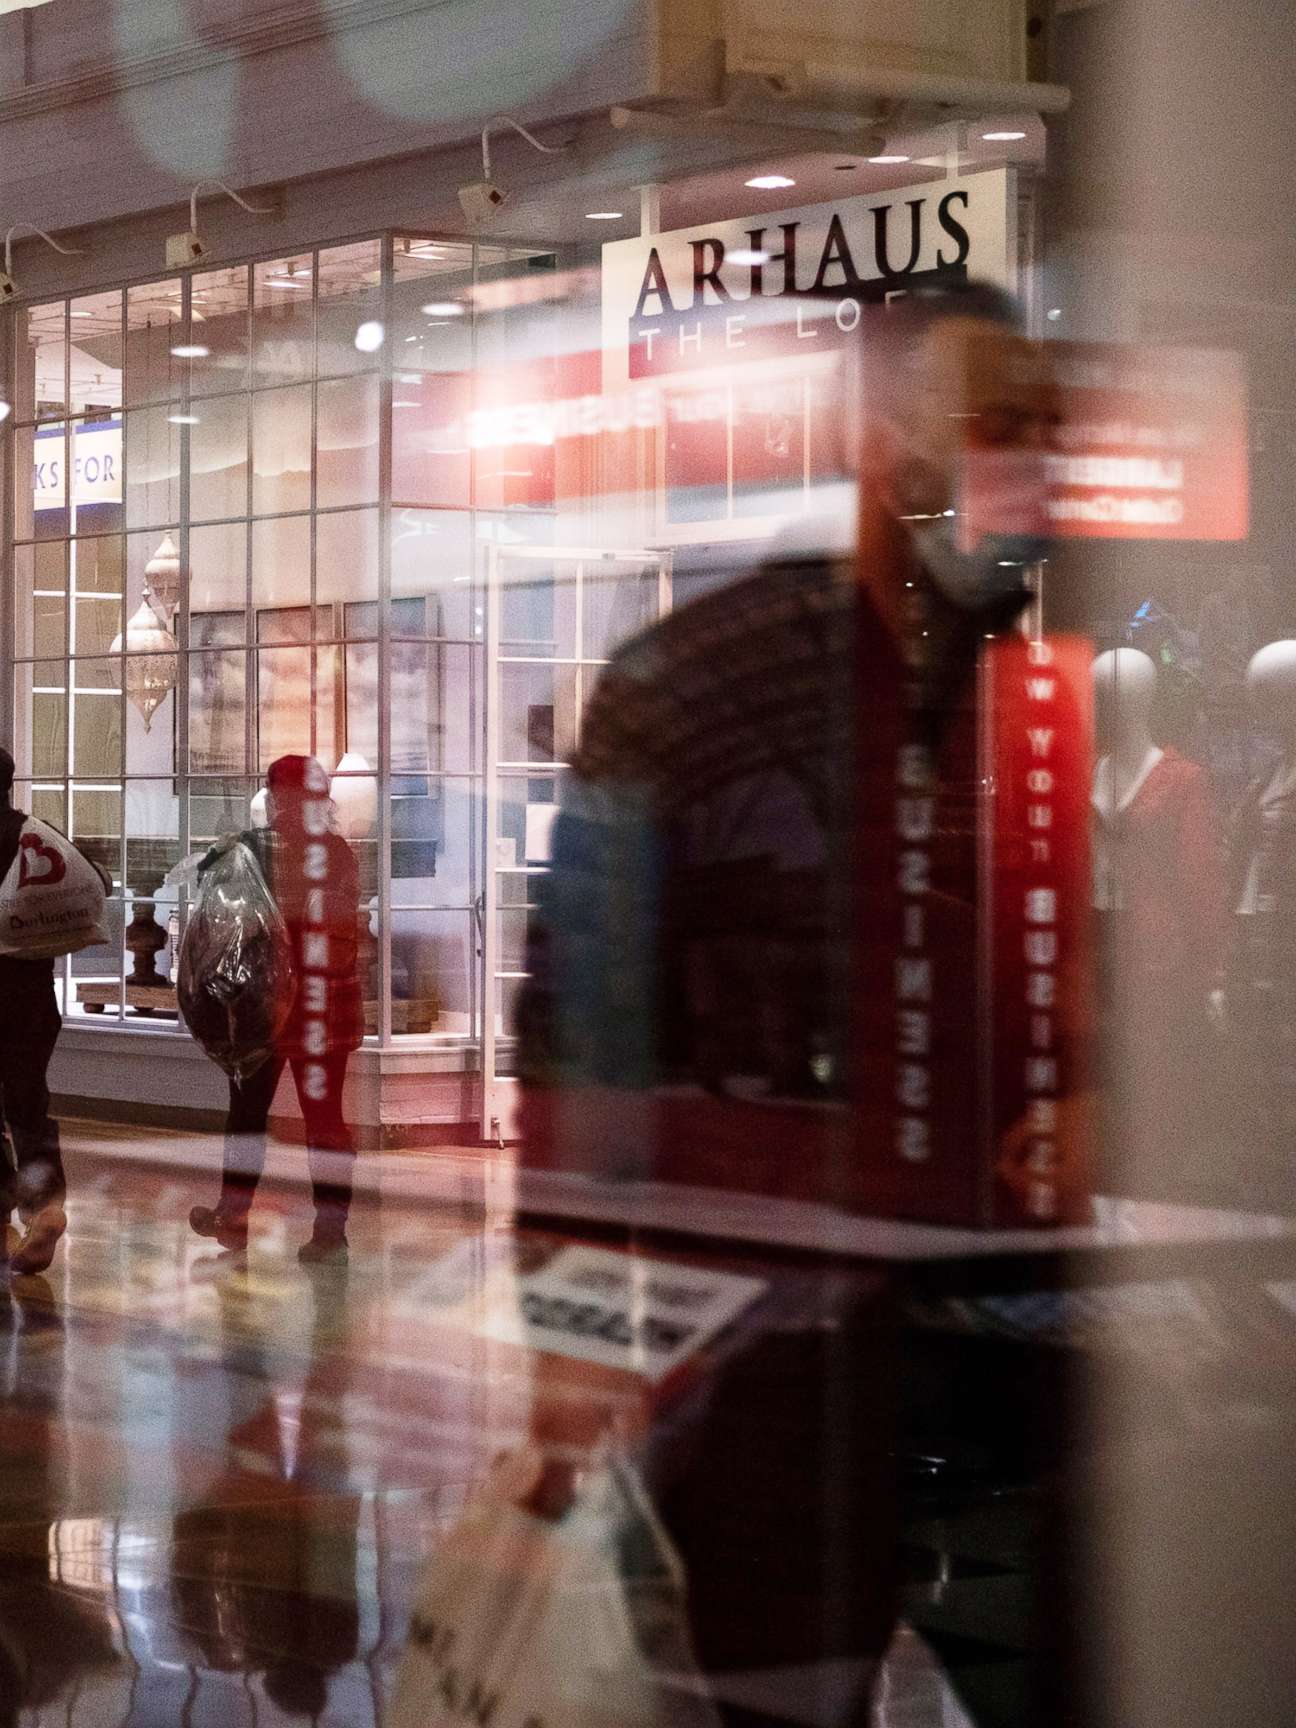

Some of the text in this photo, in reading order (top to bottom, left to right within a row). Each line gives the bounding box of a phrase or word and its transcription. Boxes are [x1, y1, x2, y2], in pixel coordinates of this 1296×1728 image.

[629, 190, 971, 320] ARHAUS
[638, 314, 747, 361] THE
[75, 454, 115, 483] FOR
[9, 907, 89, 930] Burlington
